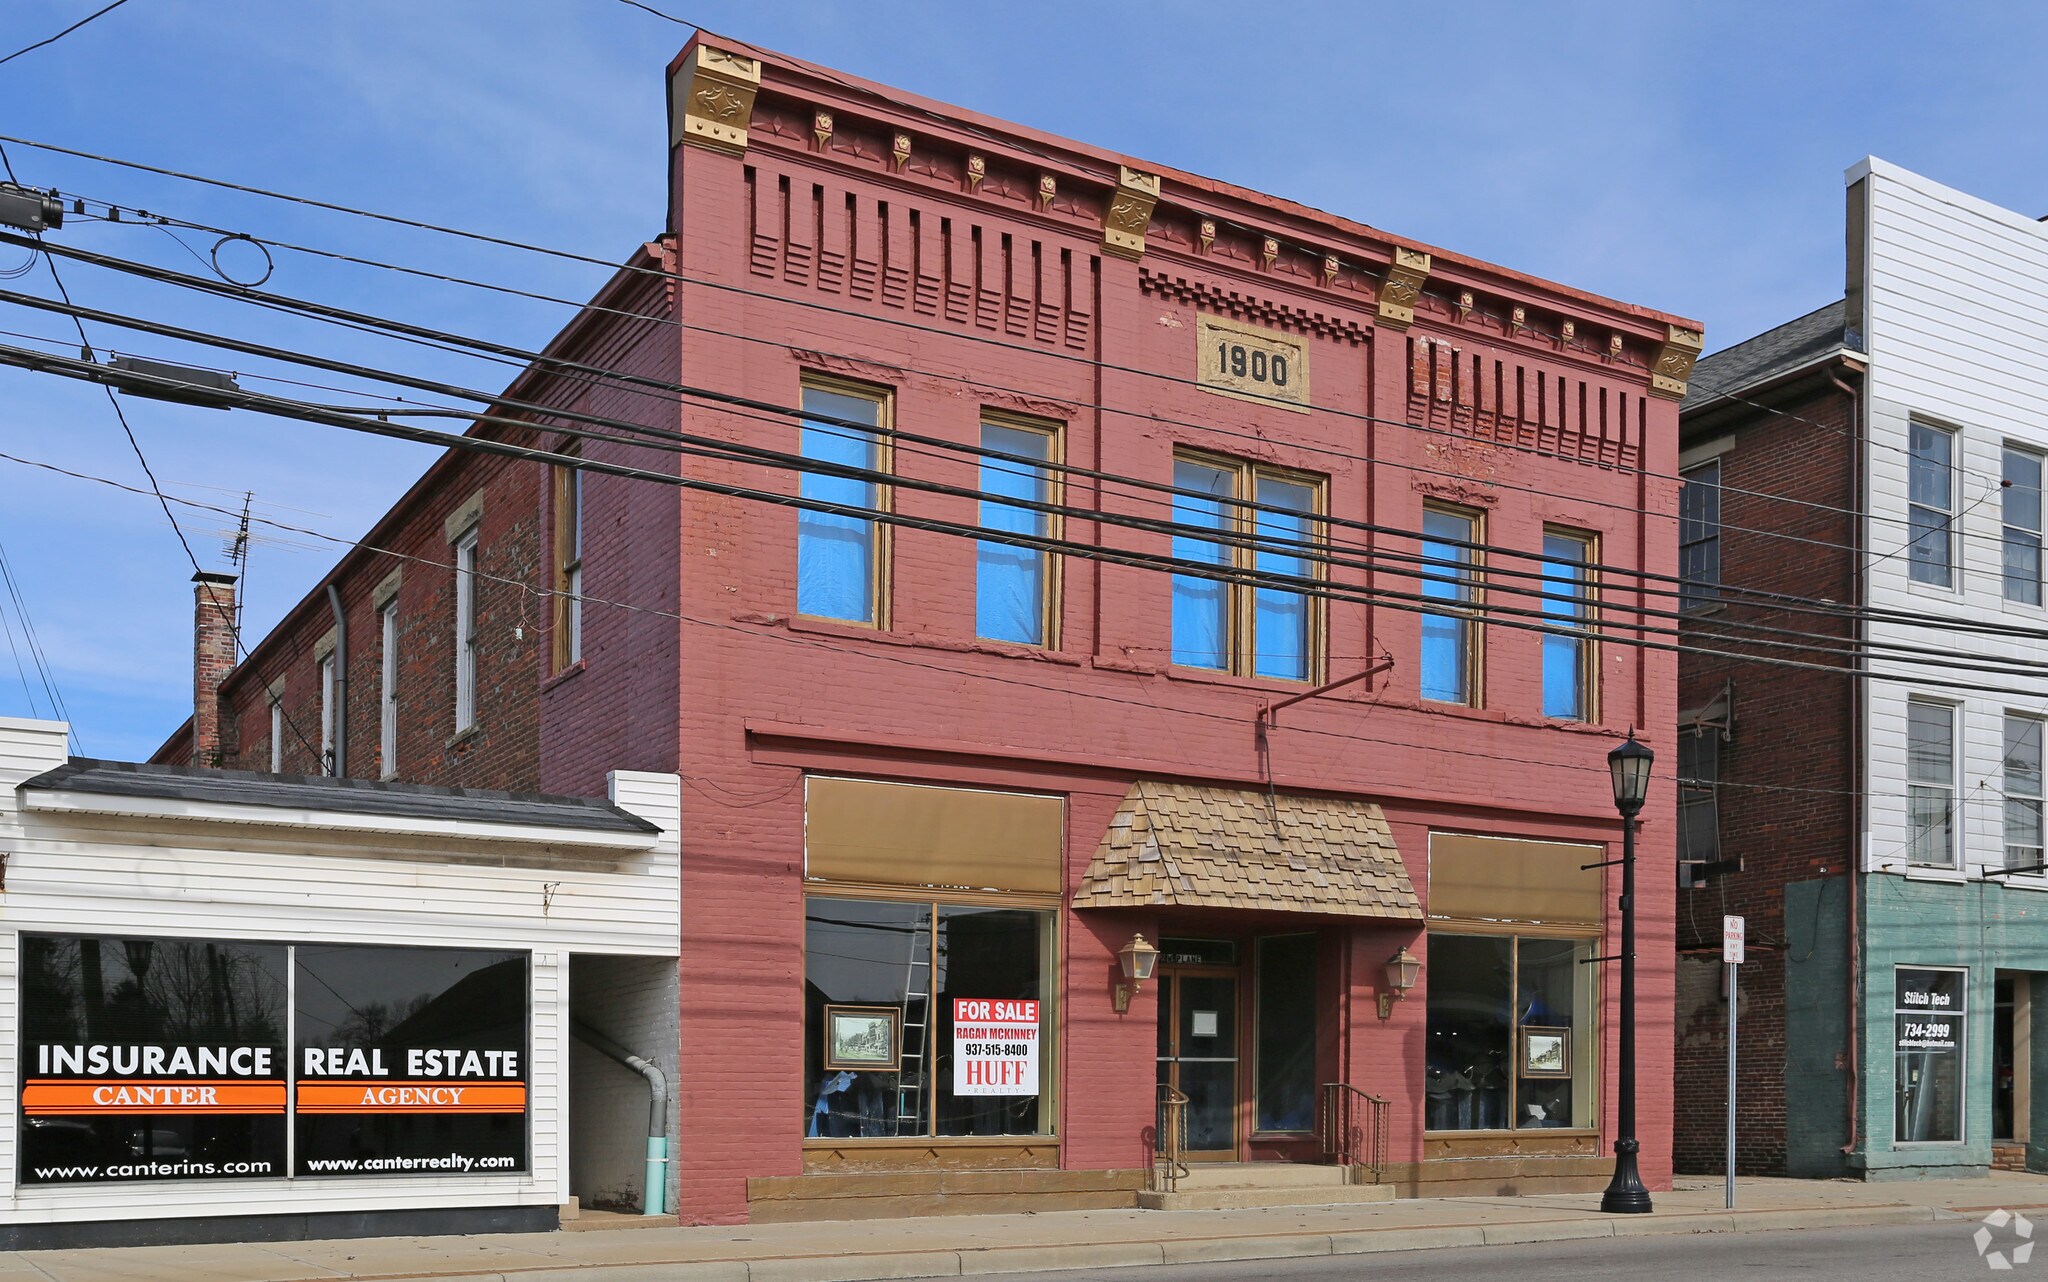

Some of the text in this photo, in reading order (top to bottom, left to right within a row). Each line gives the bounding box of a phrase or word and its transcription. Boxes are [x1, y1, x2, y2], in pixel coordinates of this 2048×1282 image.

[1218, 342, 1287, 387] 1900
[1730, 921, 1739, 929] NO
[1725, 931, 1743, 940] PARKING
[1904, 991, 1950, 1006] Stitch Tech
[958, 1001, 1035, 1021] FOR SALE
[956, 1027, 1037, 1040] RAGAN MCKINNEY
[1904, 1023, 1950, 1038] 734-2999
[965, 1043, 1028, 1056] 937-515-8400
[39, 1044, 271, 1076] INSURANCE
[304, 1047, 518, 1077] REAL ESTATE
[966, 1060, 1028, 1086] HUFF
[92, 1086, 219, 1106] CANTER
[360, 1087, 465, 1105] AGENCY
[34, 1159, 272, 1179] www.canterins.com
[307, 1153, 515, 1172] www.canterrealty.com
